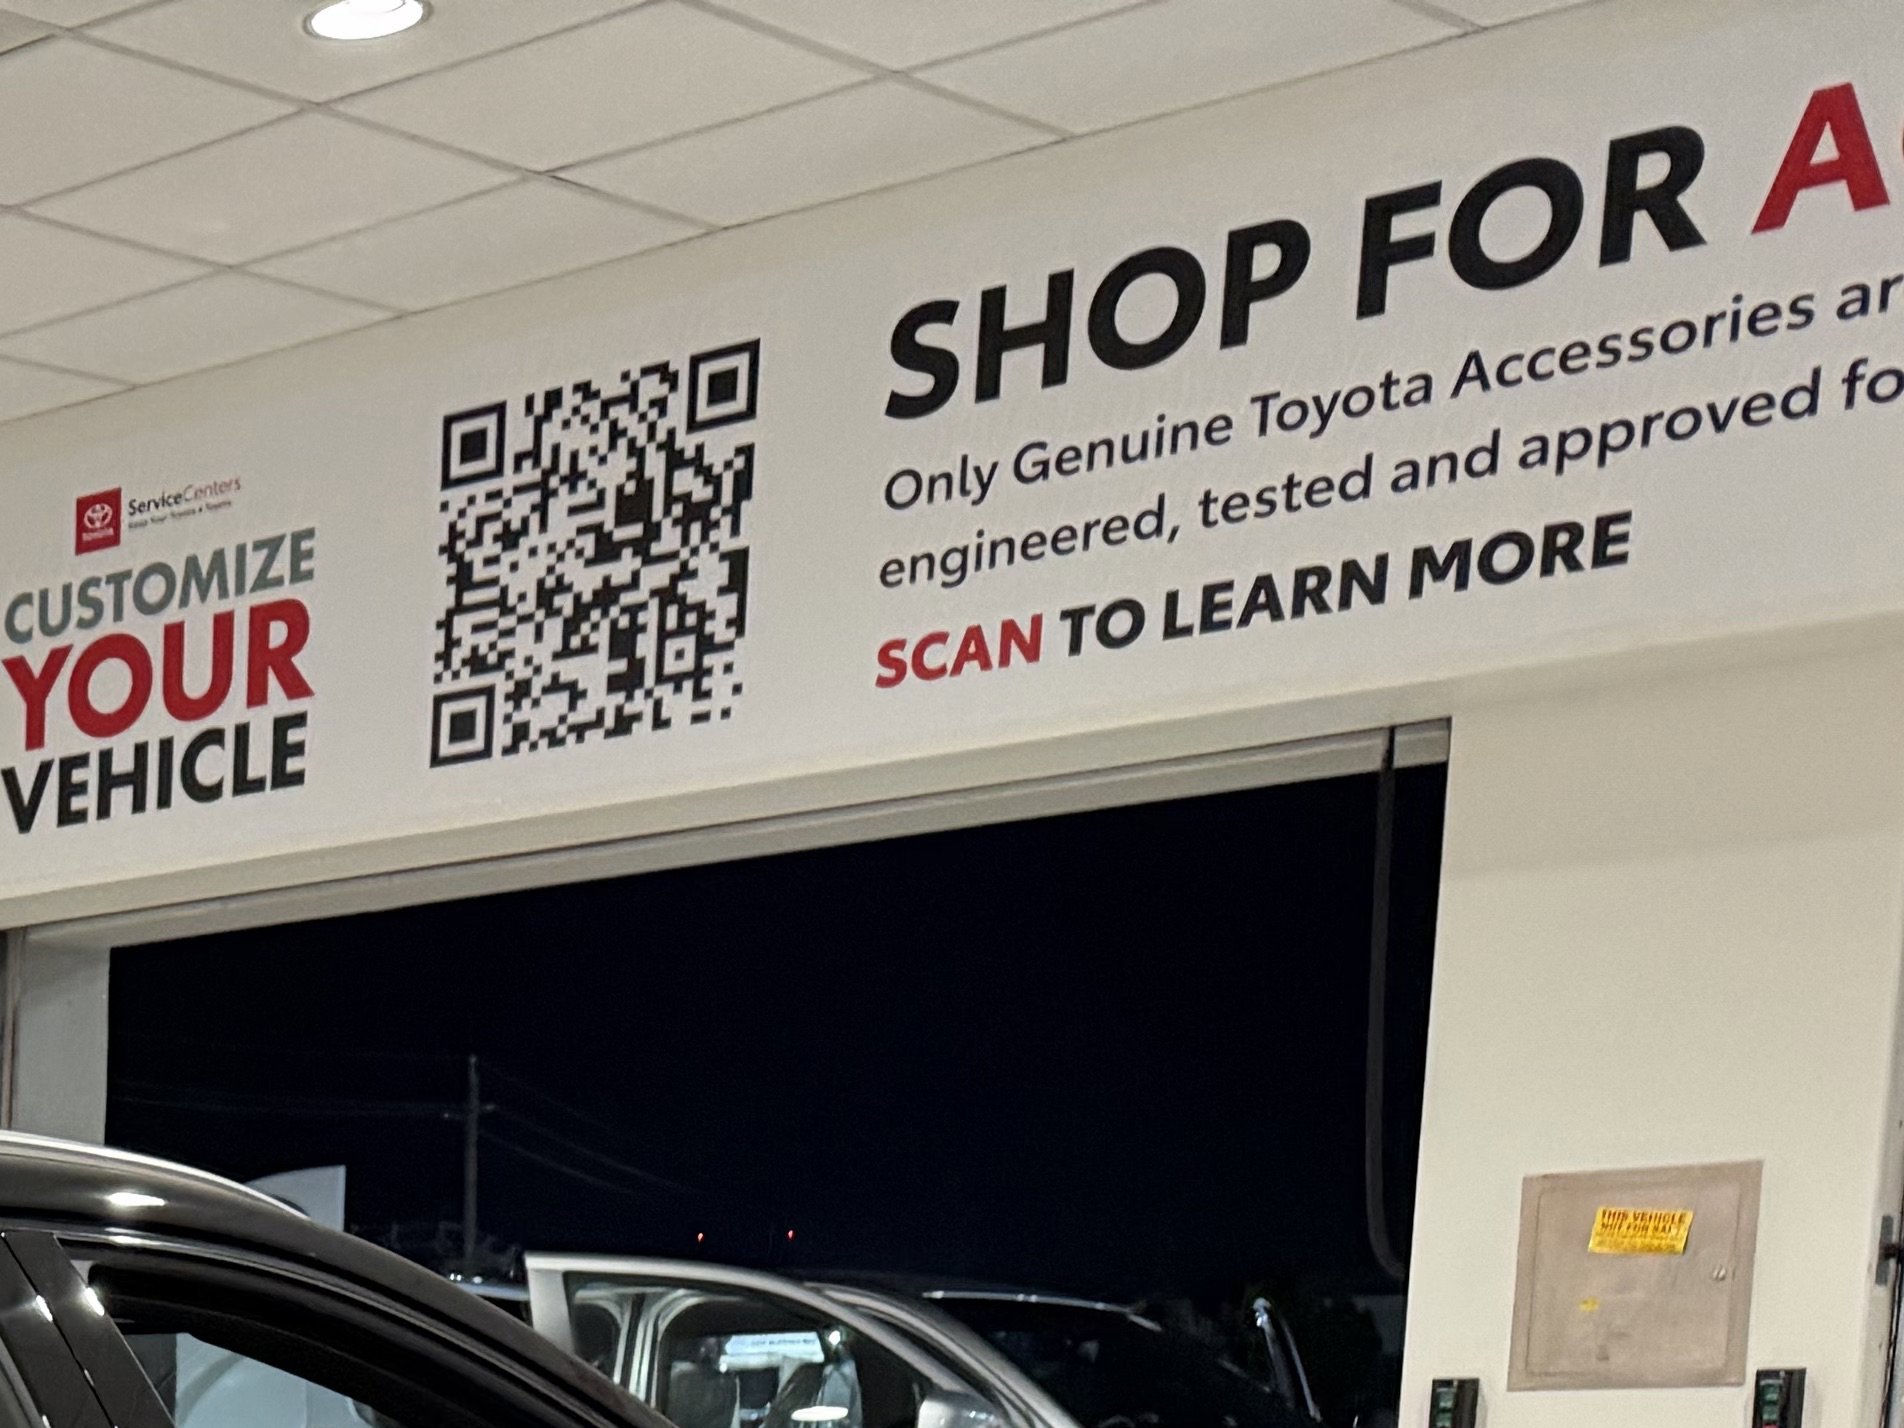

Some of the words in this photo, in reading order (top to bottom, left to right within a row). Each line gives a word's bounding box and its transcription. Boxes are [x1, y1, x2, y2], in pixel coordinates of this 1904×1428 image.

[884, 219, 1311, 419] SHOP
[1356, 124, 1708, 321] FOR
[1751, 82, 1904, 235] A
[879, 493, 1181, 588] engineered,
[1199, 453, 1373, 528] tested
[1390, 428, 1500, 494] and
[1518, 365, 1822, 476] approved
[1841, 357, 1904, 410] fo
[884, 454, 998, 511] Only
[1013, 413, 1233, 485] Genuine
[1250, 371, 1433, 439] Toyota
[1451, 293, 1815, 398] Accessories
[1836, 274, 1904, 320] ar
[0, 598, 316, 752] YOUR
[3, 526, 316, 644] CUSTOMIZE
[875, 612, 1044, 689] SCAN
[1060, 597, 1146, 656] TO
[1162, 552, 1389, 641] LEARN
[1408, 509, 1633, 600] MORE
[0, 710, 308, 835] VEHICLE
